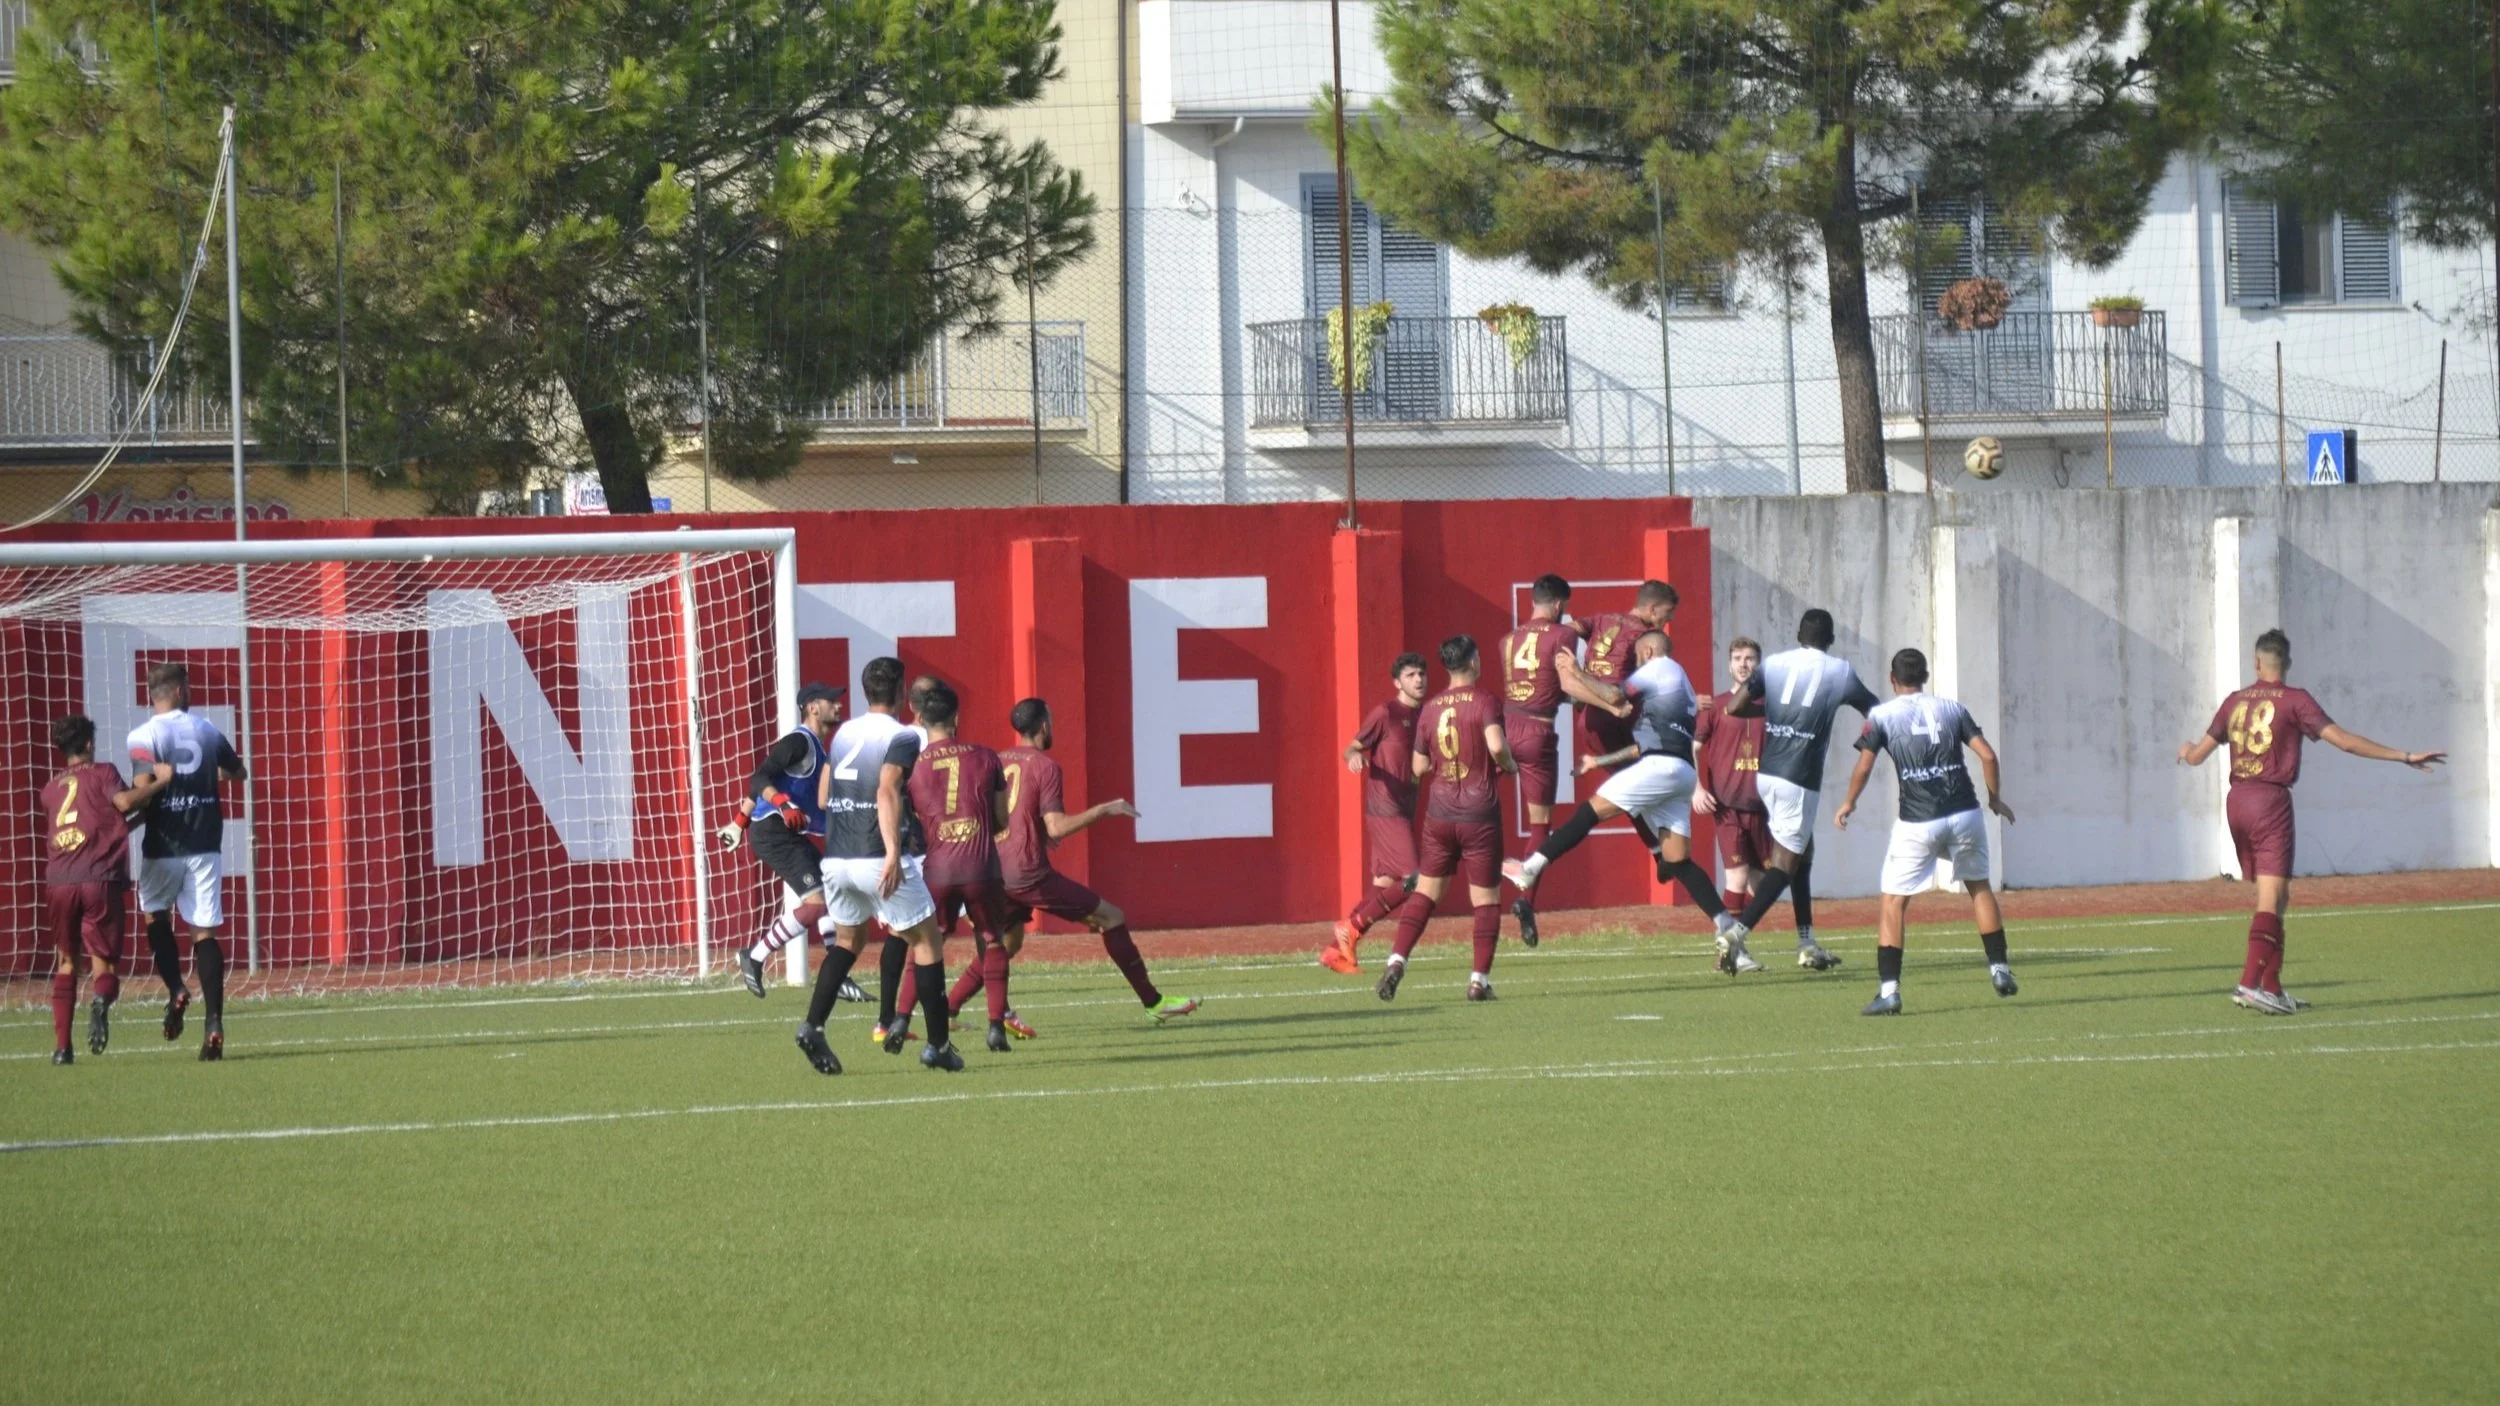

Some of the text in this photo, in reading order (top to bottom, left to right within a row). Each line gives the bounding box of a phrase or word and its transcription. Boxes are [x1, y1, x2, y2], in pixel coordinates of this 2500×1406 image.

[1505, 632, 1540, 680] 14
[1437, 707, 1460, 759] 6
[1911, 697, 1941, 744] 4
[2228, 700, 2275, 755] 48
[173, 720, 203, 774] 5
[834, 729, 865, 780] 2
[56, 775, 78, 828] 2
[932, 756, 960, 816] 7
